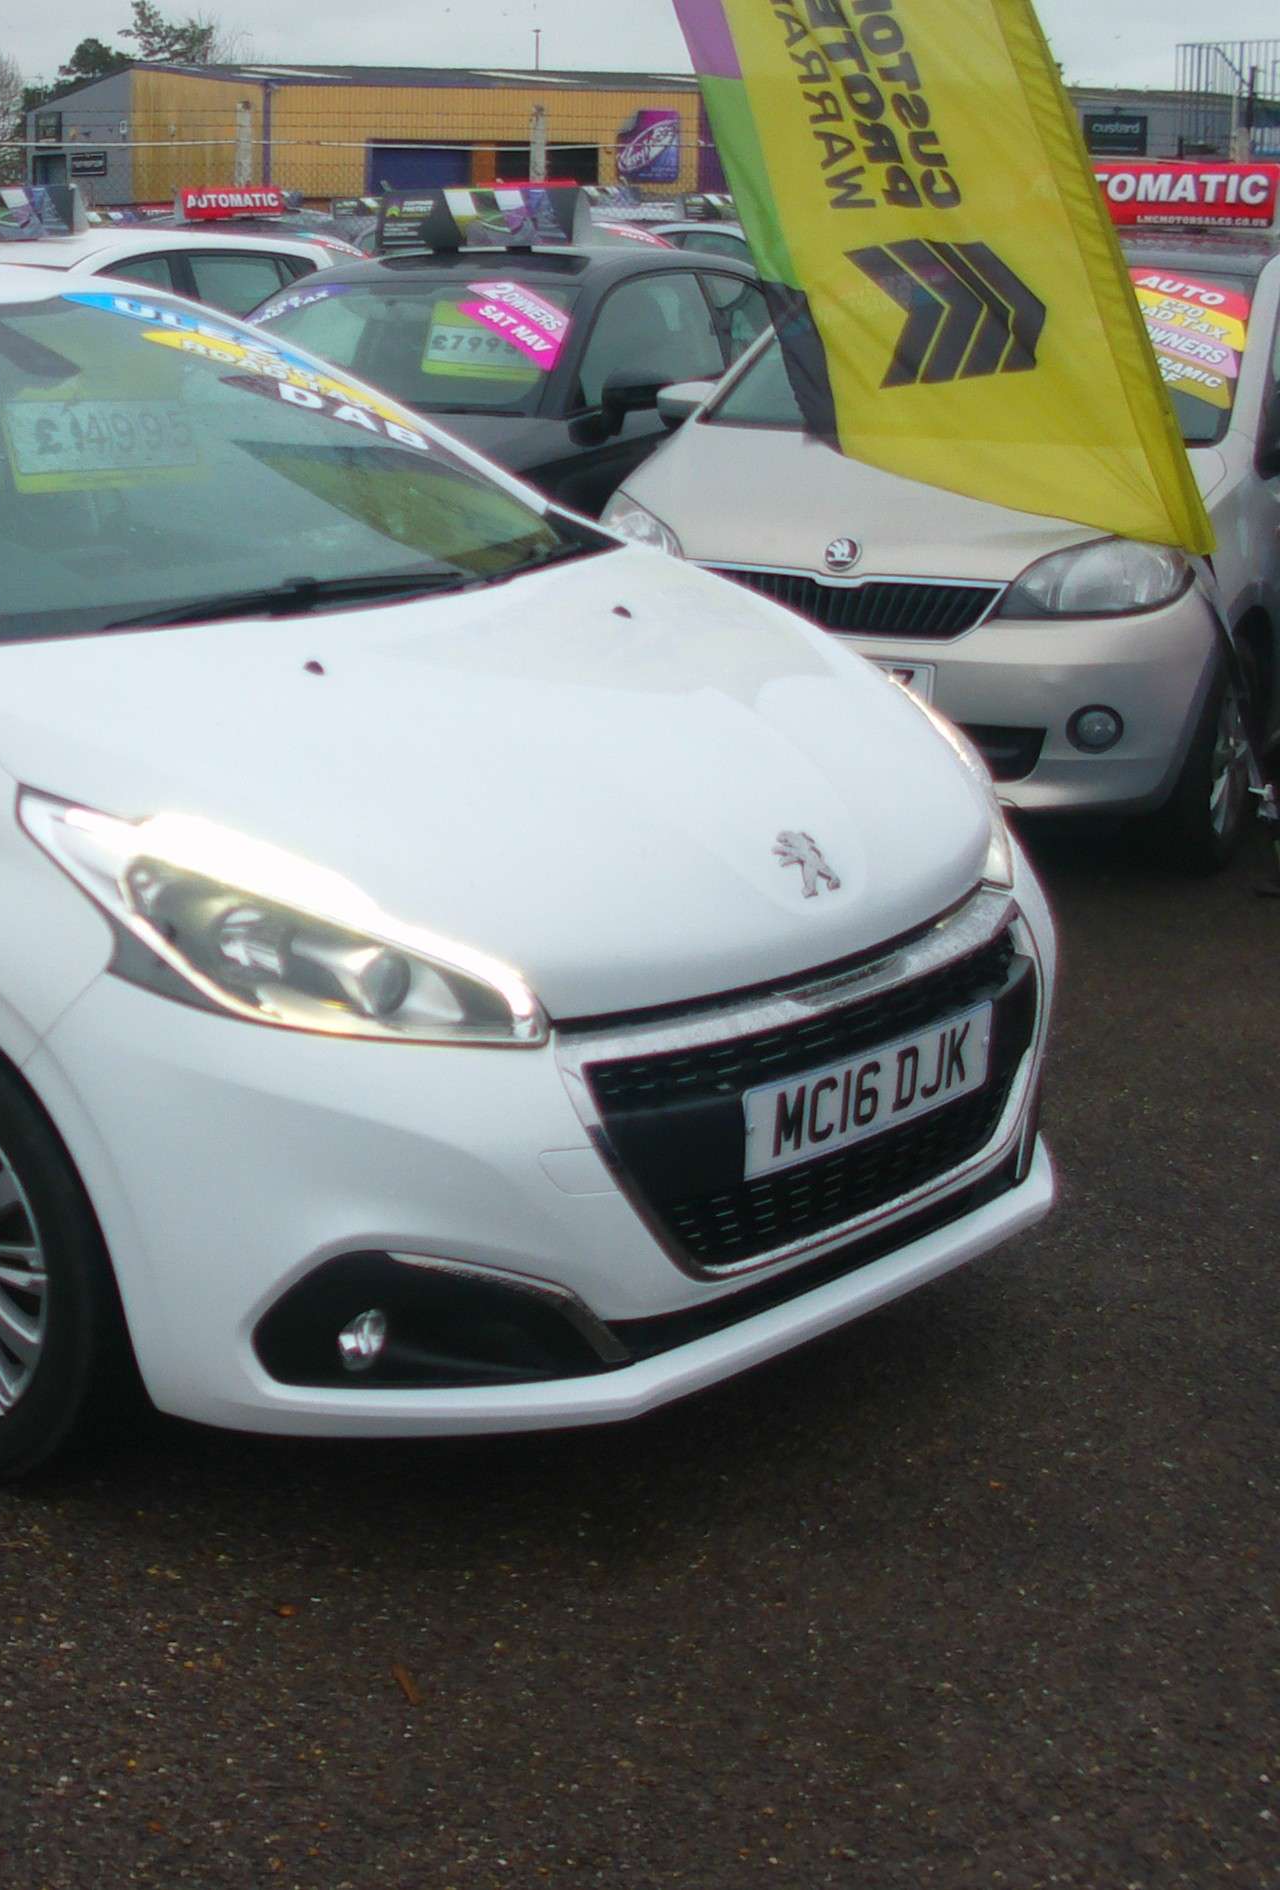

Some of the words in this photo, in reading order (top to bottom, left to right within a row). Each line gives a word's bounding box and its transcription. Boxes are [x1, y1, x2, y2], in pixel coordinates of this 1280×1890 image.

[1091, 121, 1140, 134] custard
[187, 192, 279, 208] AUTOMATIC
[1135, 275, 1225, 305] AUTO
[478, 304, 519, 328] SAT
[510, 325, 554, 352] NAV
[501, 292, 563, 332] OWNERS
[1140, 304, 1176, 321] AD
[1183, 316, 1229, 339] TAX
[278, 381, 430, 450] DAB
[772, 1060, 882, 1158] MC16
[892, 1021, 971, 1113] DJK
